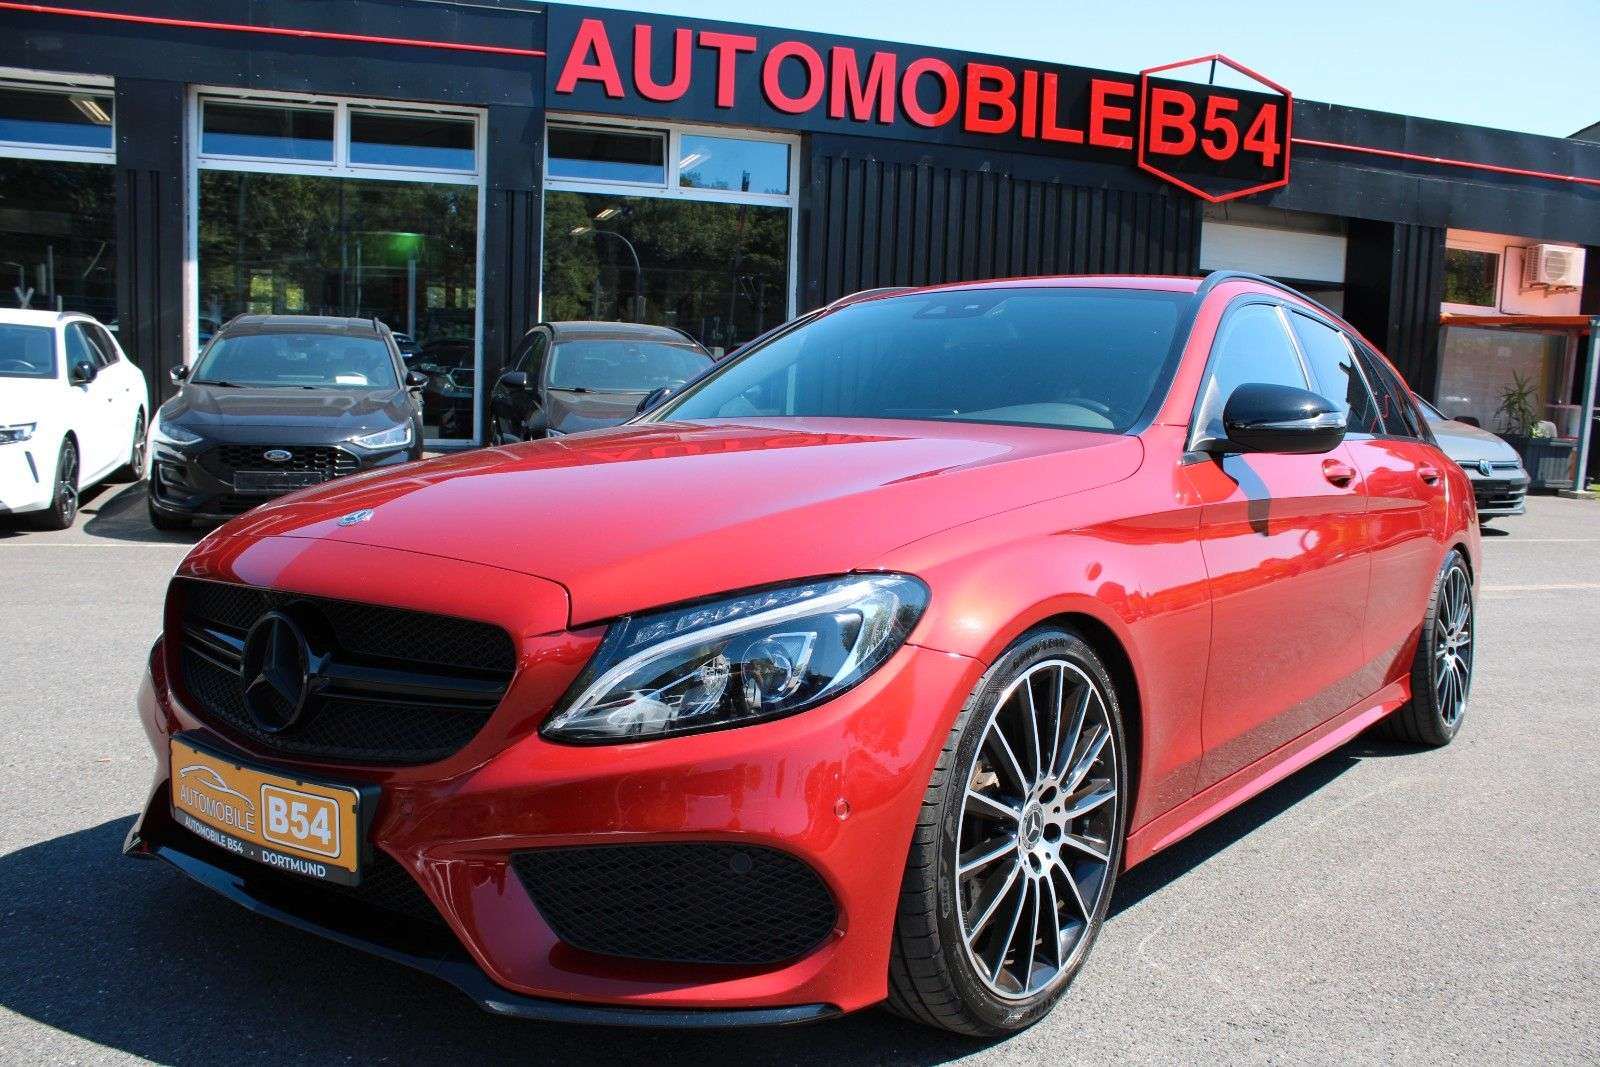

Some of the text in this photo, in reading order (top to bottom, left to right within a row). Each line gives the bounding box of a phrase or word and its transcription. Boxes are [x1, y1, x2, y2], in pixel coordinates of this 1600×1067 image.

[556, 19, 1281, 167] AUTOMOBILE B54
[180, 785, 256, 833] AUTOMOBILE
[268, 796, 332, 844] B54
[184, 816, 326, 878] AUTOMOBILE B54 DORTMUND
